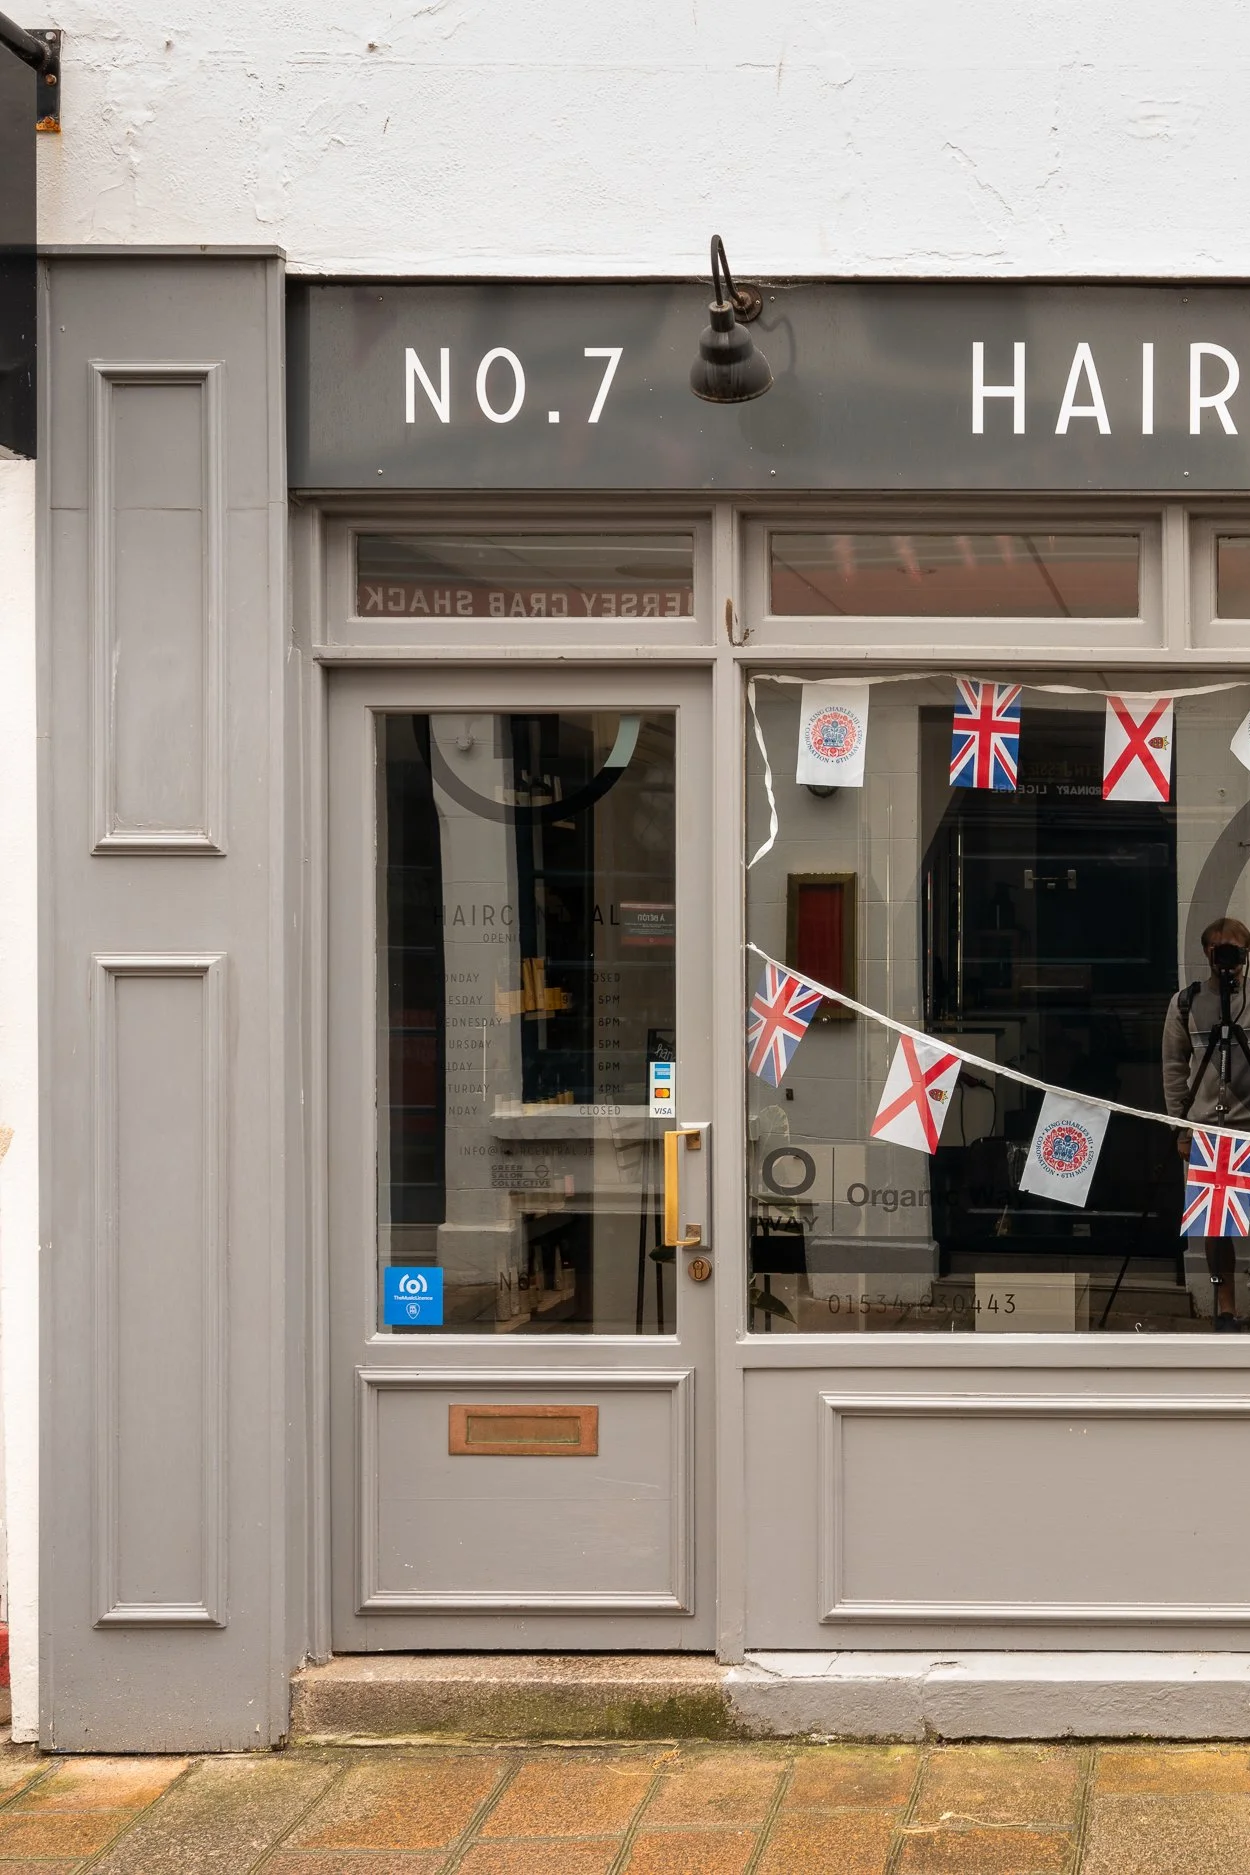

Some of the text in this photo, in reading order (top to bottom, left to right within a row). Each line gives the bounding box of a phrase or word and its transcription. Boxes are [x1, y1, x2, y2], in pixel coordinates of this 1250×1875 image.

[405, 347, 624, 424] NO.7
[972, 341, 1241, 435] HAIR
[442, 973, 621, 983] NDAY OSED
[445, 995, 483, 1005] ESDAY
[441, 1017, 503, 1028] EDNESDAY
[446, 1039, 492, 1049] URSDAY
[446, 1084, 491, 1094] TURDAY
[579, 1106, 621, 1116] CLOSED
[654, 1107, 673, 1115] VISA
[847, 1182, 959, 1213] Organic
[758, 1215, 819, 1232] WAY
